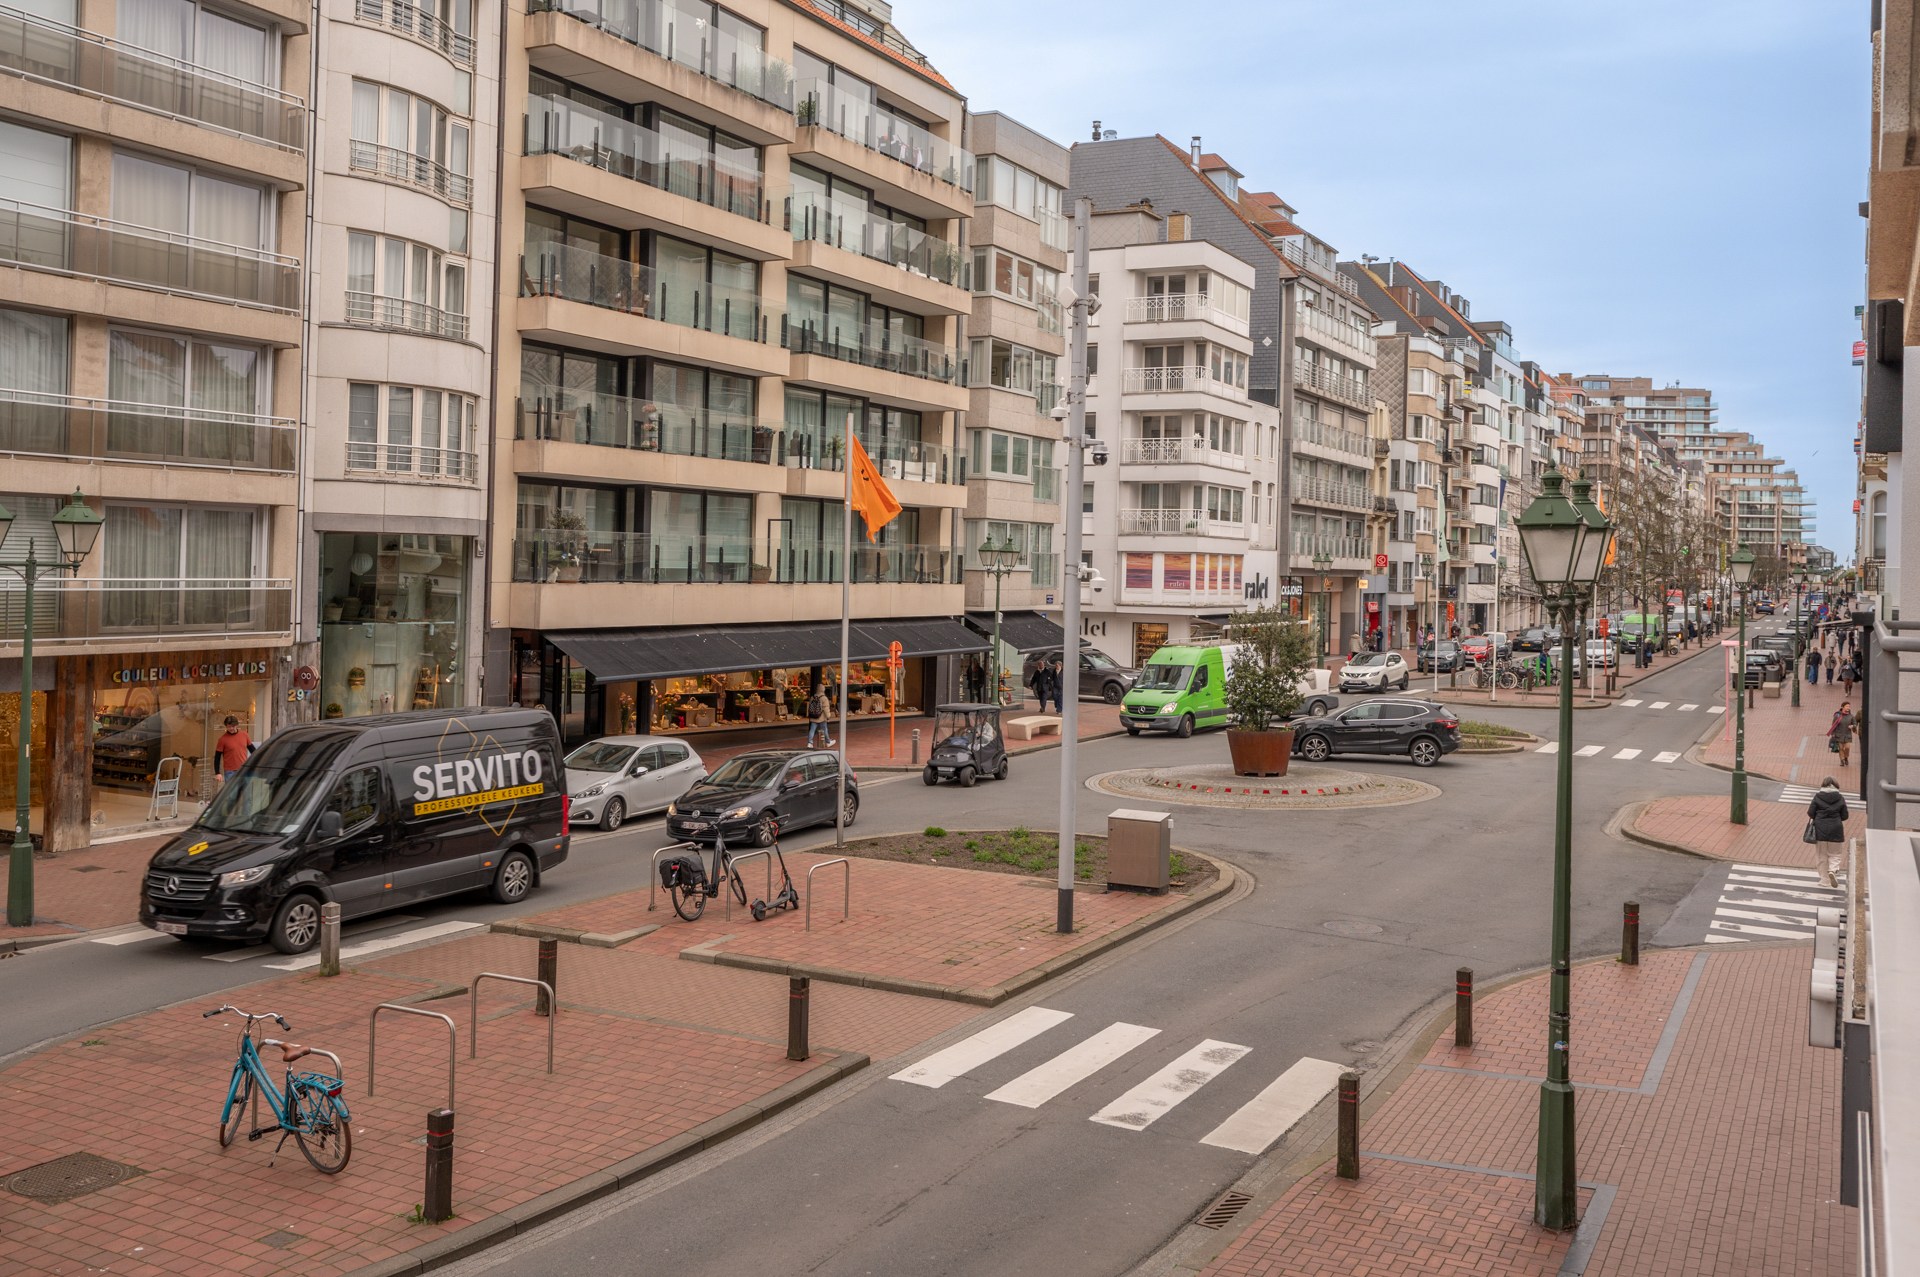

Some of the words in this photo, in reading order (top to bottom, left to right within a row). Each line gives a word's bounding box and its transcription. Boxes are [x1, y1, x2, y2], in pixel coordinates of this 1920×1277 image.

[1080, 617, 1107, 636] let
[112, 666, 176, 683] COULEUR
[182, 663, 232, 680] LOCALE
[237, 660, 267, 675] KIDS
[412, 749, 543, 802] SERVITO
[415, 793, 498, 814] PROFESSIONELE
[501, 784, 544, 799] KEUKENS
